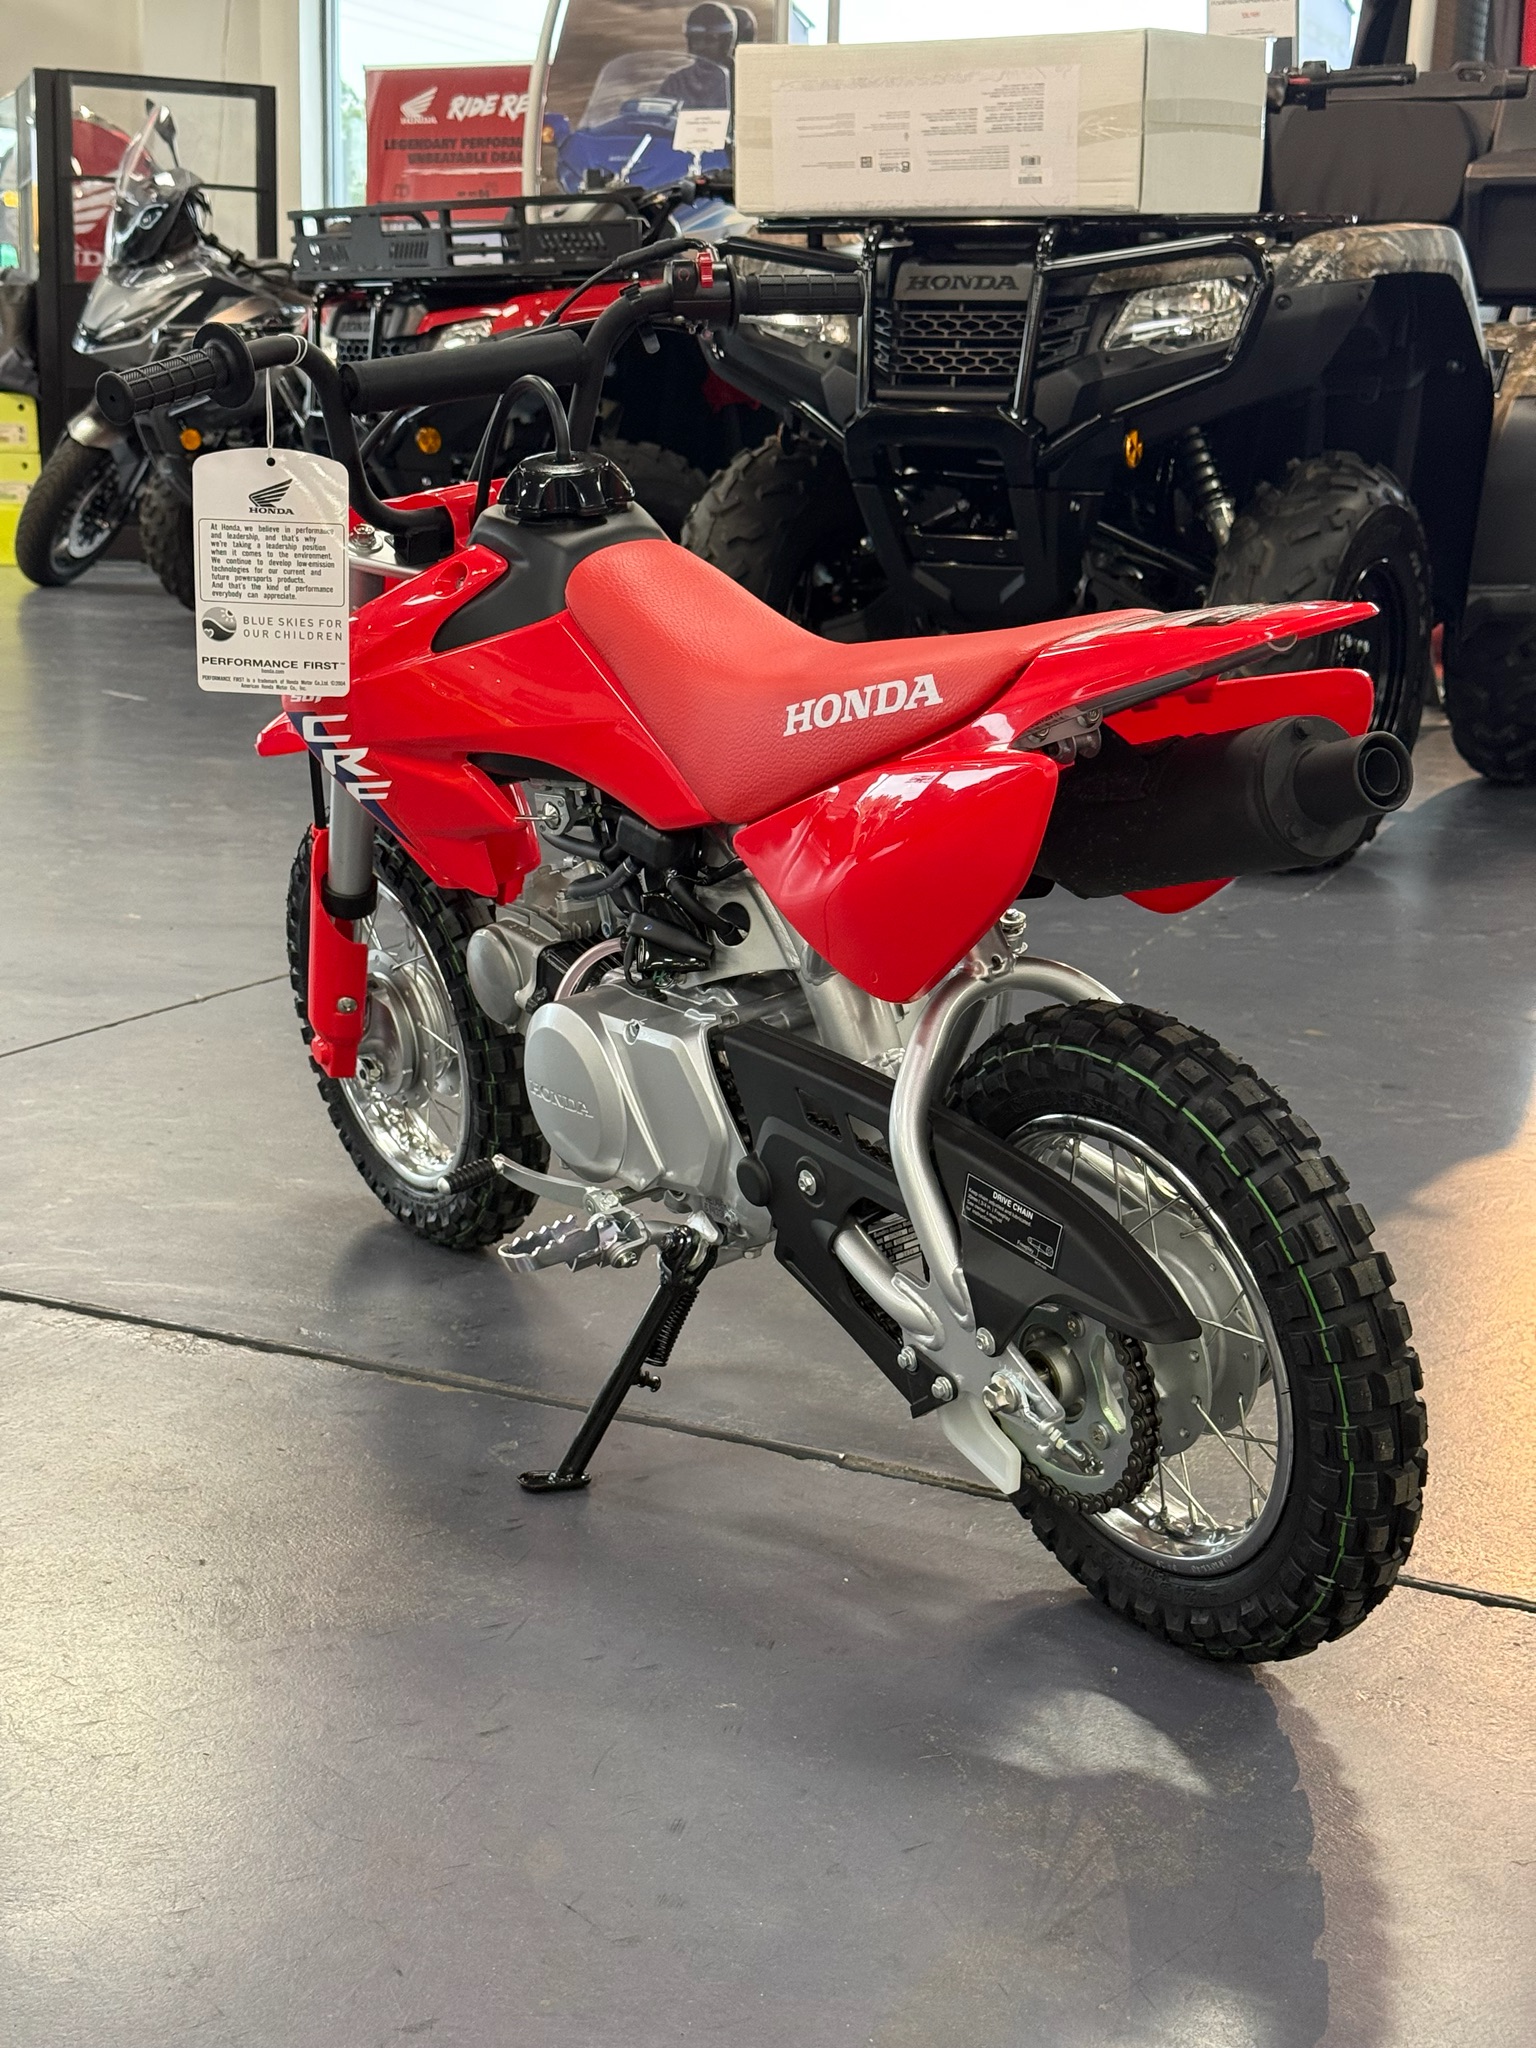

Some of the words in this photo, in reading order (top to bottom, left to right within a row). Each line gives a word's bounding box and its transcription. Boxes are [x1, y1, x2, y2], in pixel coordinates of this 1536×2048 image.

[447, 94, 499, 122] RIDE
[384, 138, 456, 150] LEGENDARY
[408, 152, 487, 164] UNBEATABLE
[905, 275, 1020, 291] HONDA
[249, 506, 295, 515] HONDA
[211, 523, 217, 531] At
[258, 525, 280, 533] believe
[304, 535, 316, 544] why
[232, 541, 251, 550] taking
[266, 542, 298, 551] leadership
[211, 565, 249, 574] technologies
[269, 559, 292, 568] develop
[266, 583, 279, 591] kind
[296, 585, 334, 593] performance
[212, 590, 242, 599] everybody
[243, 616, 274, 626] BLUE
[278, 617, 314, 628] SKIES
[318, 619, 342, 629] FOR
[243, 629, 270, 639] OUR
[274, 630, 342, 641] CHILDREN
[201, 656, 299, 669] PERFORMANCE
[783, 673, 944, 737] HONDA
[528, 1079, 594, 1119] HONDA
[992, 1191, 1012, 1208] DRIVE
[1012, 1203, 1034, 1220] CHAIN
